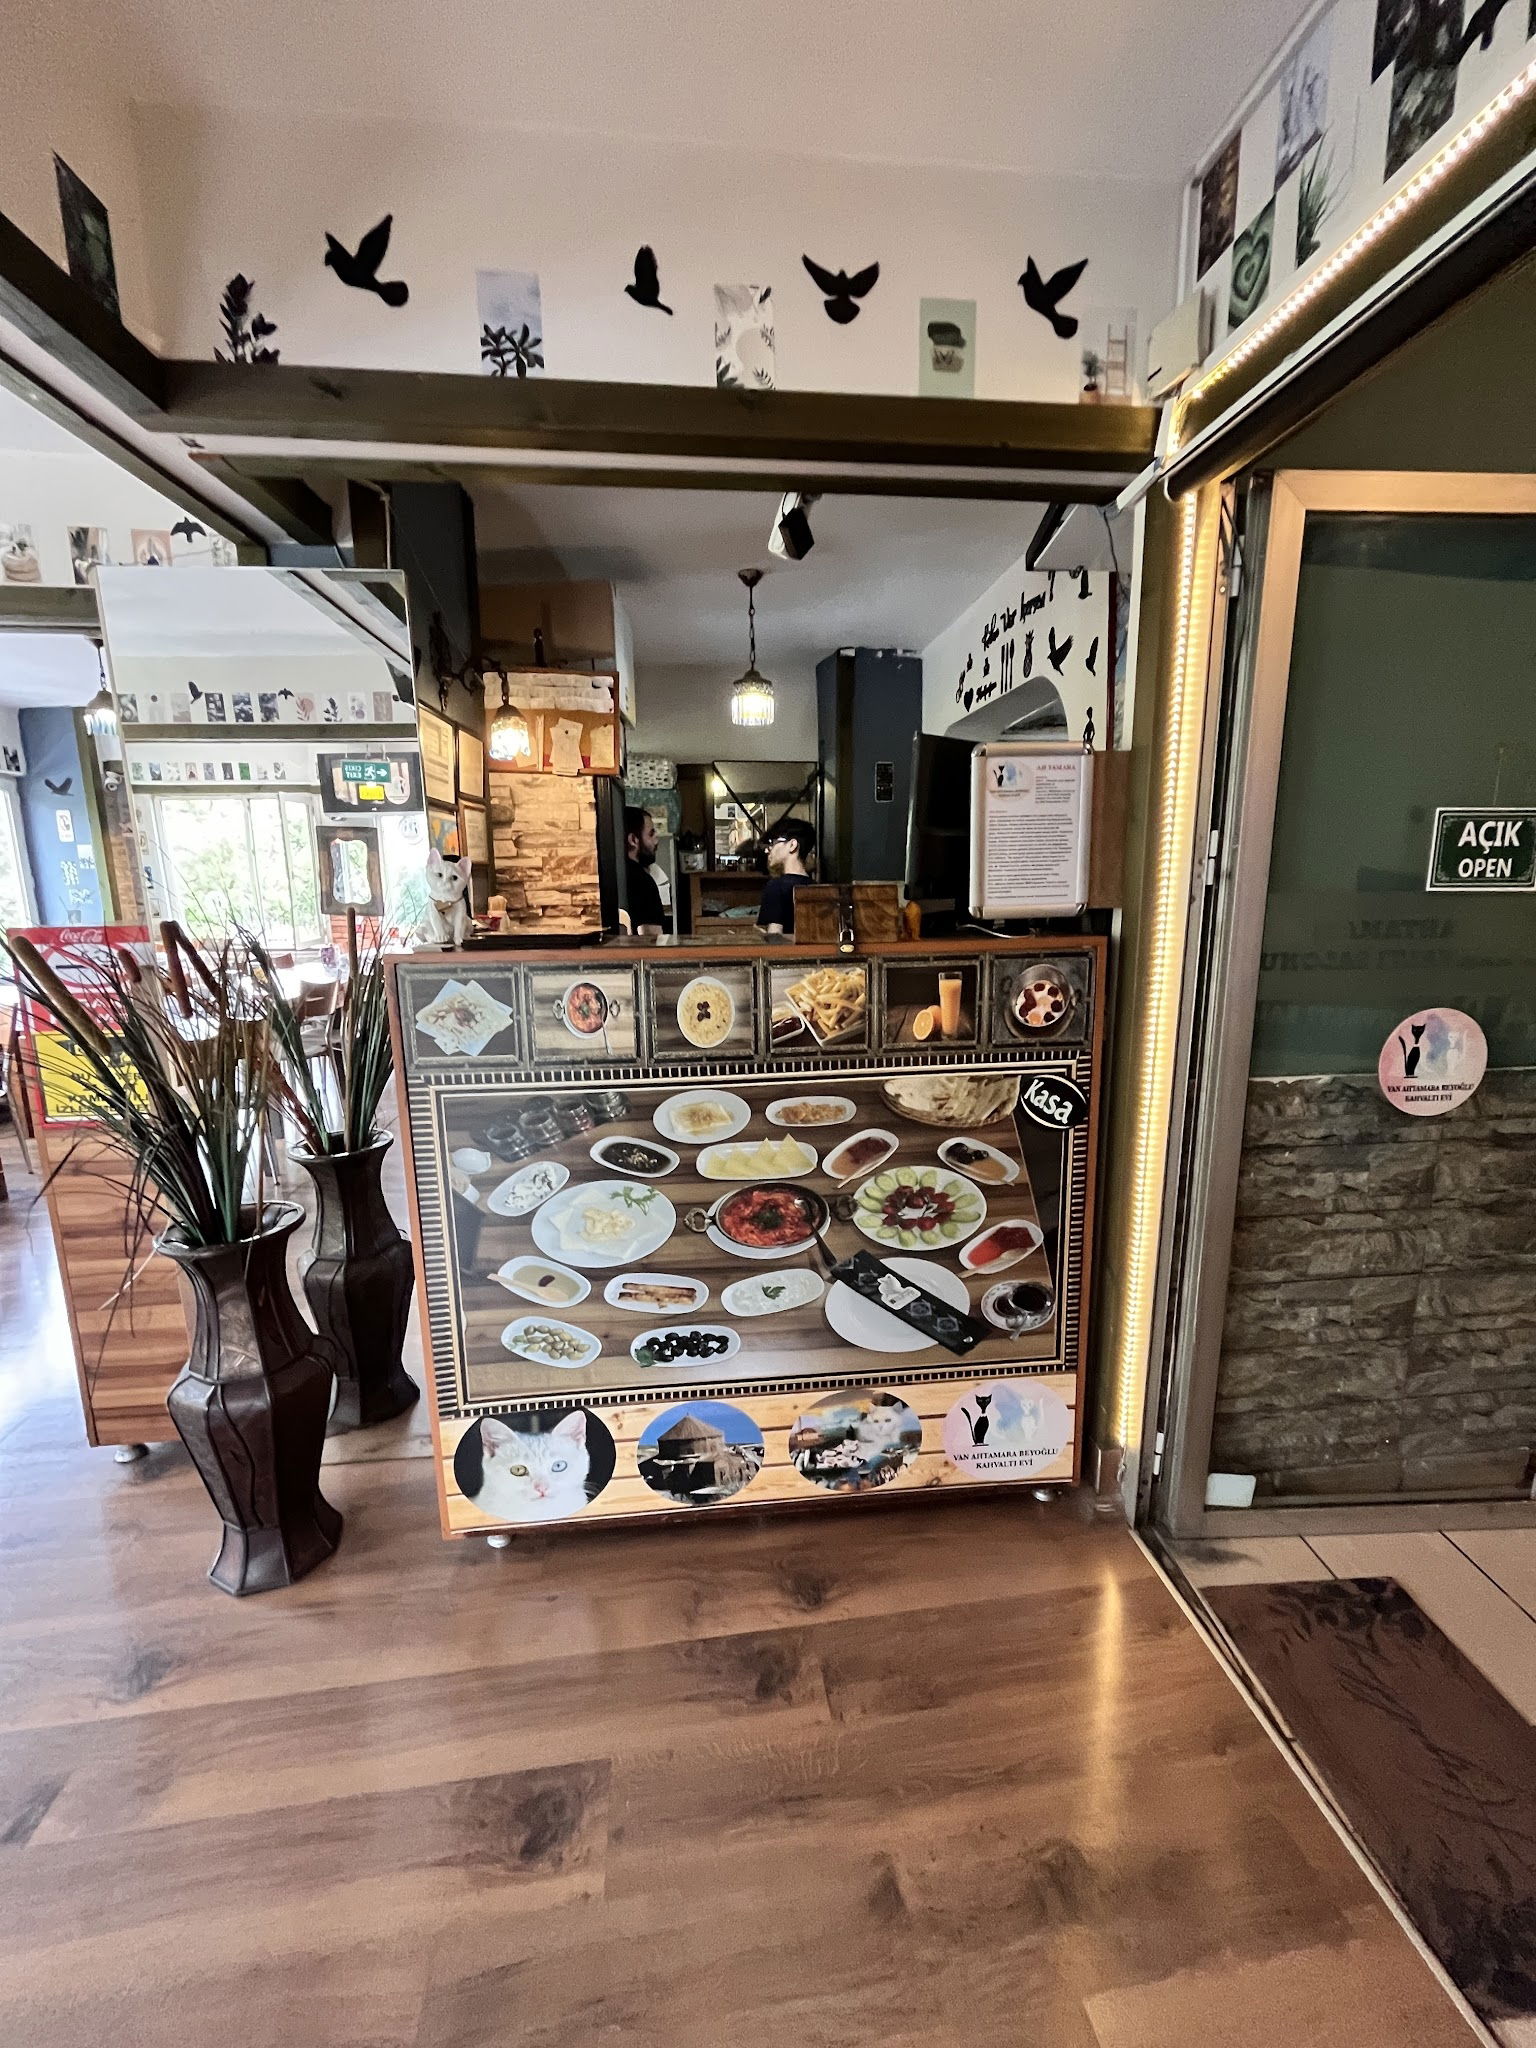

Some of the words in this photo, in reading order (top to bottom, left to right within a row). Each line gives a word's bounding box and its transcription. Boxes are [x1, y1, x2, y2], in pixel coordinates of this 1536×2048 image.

[1457, 820, 1524, 854] AÇIK
[1458, 857, 1513, 878] OPEN
[1023, 1078, 1073, 1125] Kasa
[953, 1453, 972, 1461] VAN
[1019, 1447, 1059, 1457] BEYOĞLU
[976, 1460, 1017, 1469] KAHVALTI
